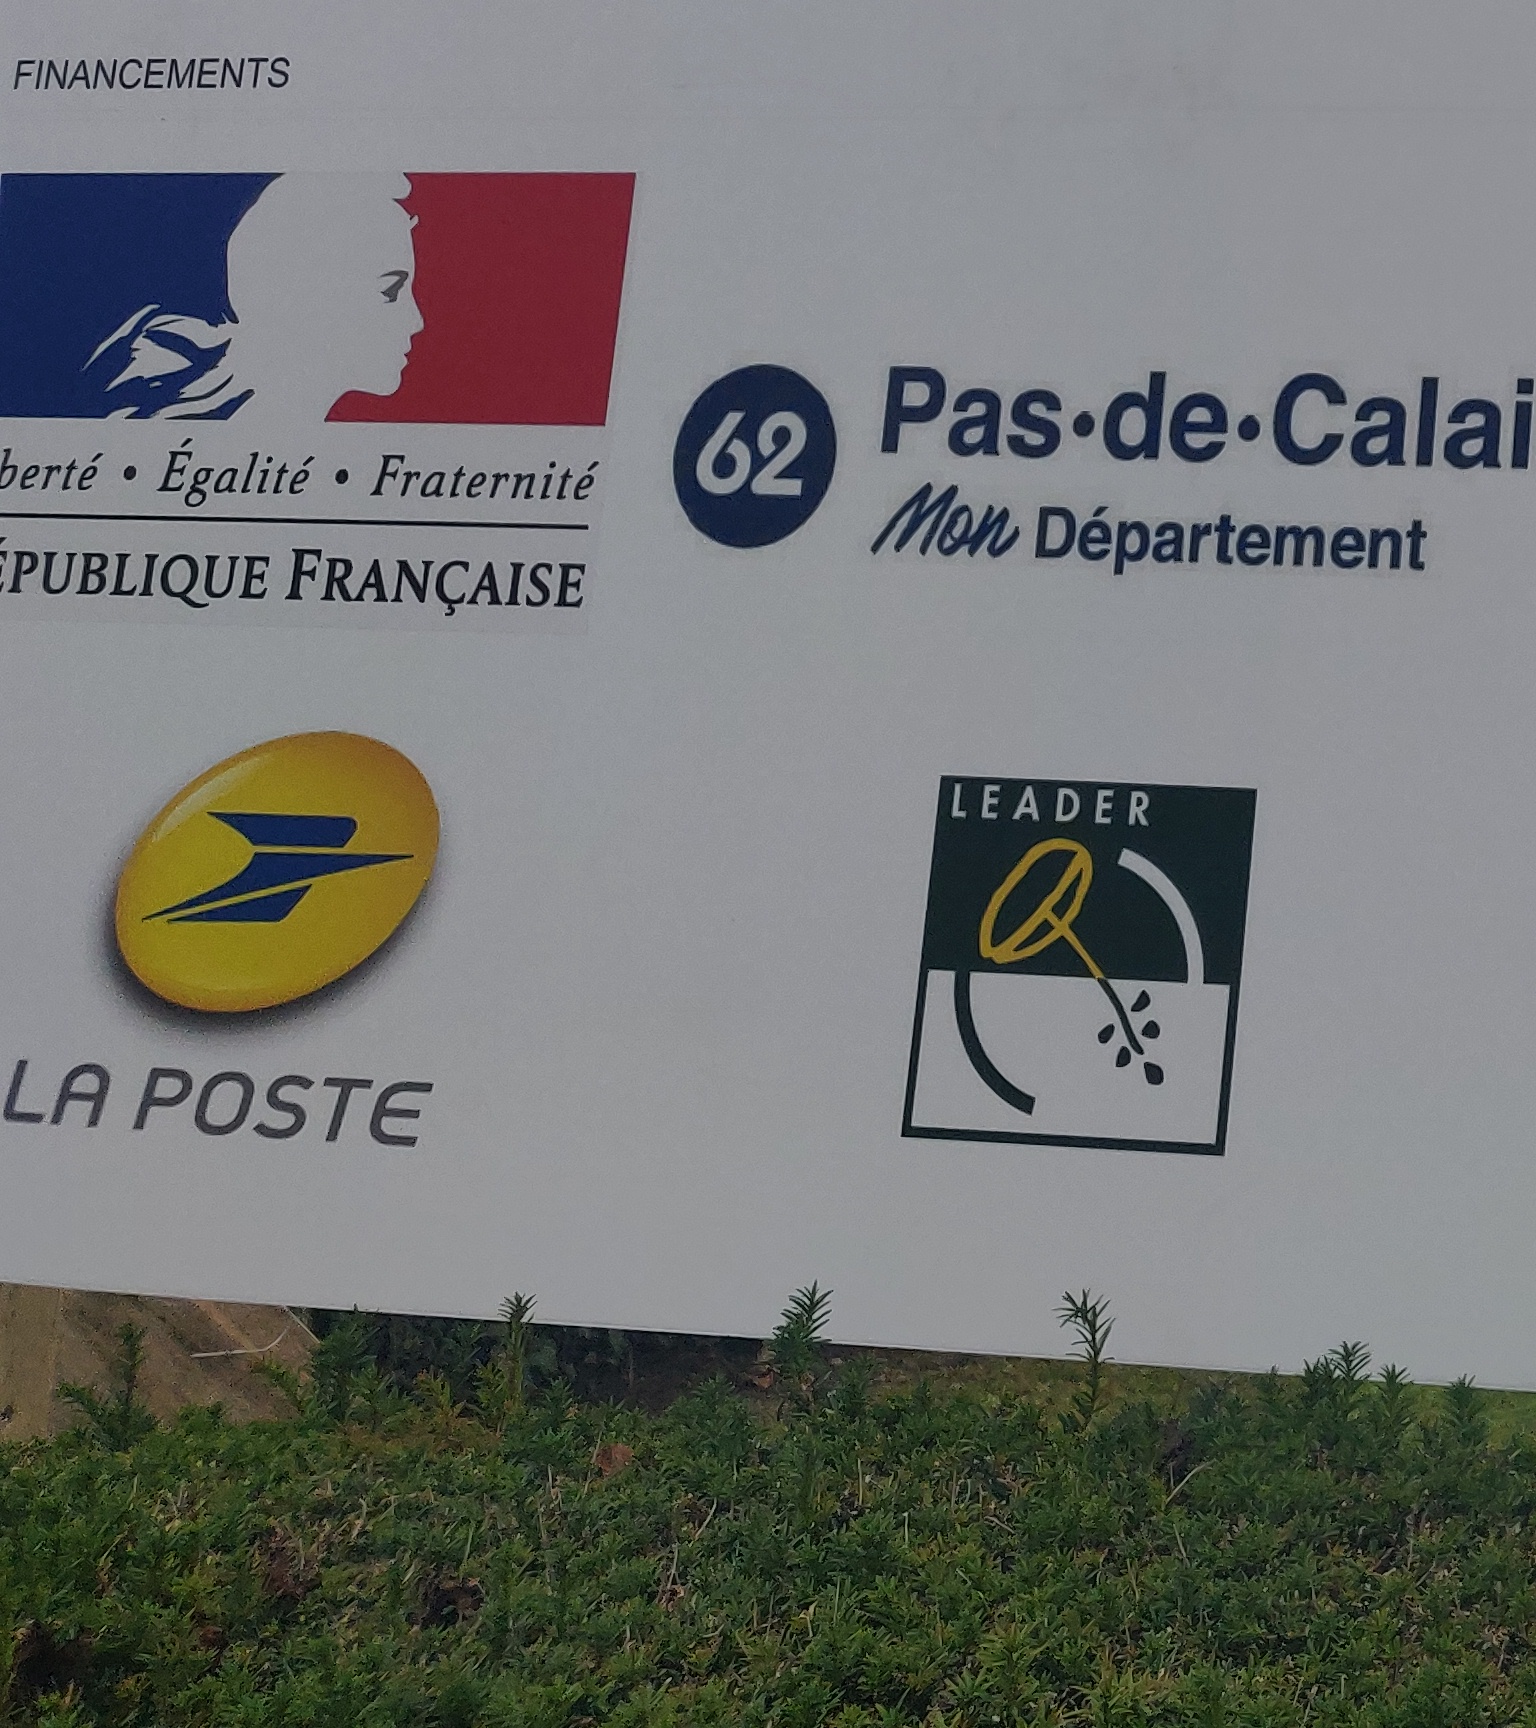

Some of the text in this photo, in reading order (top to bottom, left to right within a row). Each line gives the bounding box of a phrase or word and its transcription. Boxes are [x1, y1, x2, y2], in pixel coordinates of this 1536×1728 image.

[13, 56, 291, 90] FINANCEMENTS
[155, 437, 316, 508] Égalité
[369, 454, 600, 501] Fraternité
[695, 407, 810, 500] 62
[870, 481, 1428, 577] Mon Département
[284, 548, 587, 617] FRANÇAISE
[949, 782, 1152, 827] LEADER
[2, 1059, 435, 1148] LA POSTE
